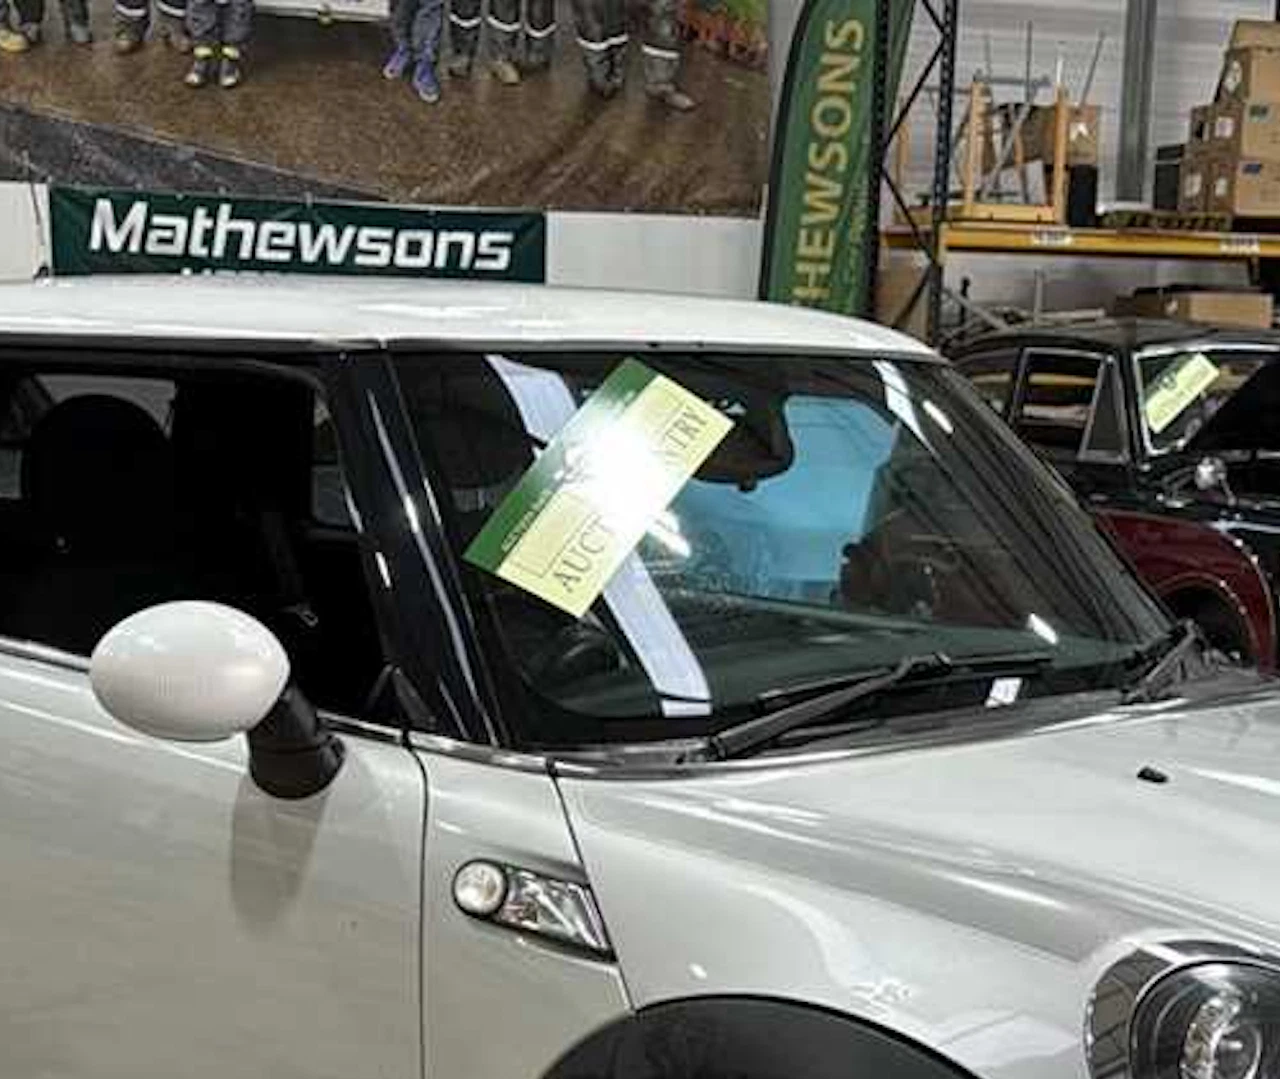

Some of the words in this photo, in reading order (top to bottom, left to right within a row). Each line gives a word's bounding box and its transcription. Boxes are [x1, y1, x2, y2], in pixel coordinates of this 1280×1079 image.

[792, 18, 865, 302] HEWSONS
[89, 197, 515, 271] Mathewsons
[553, 513, 615, 592] AUCT
